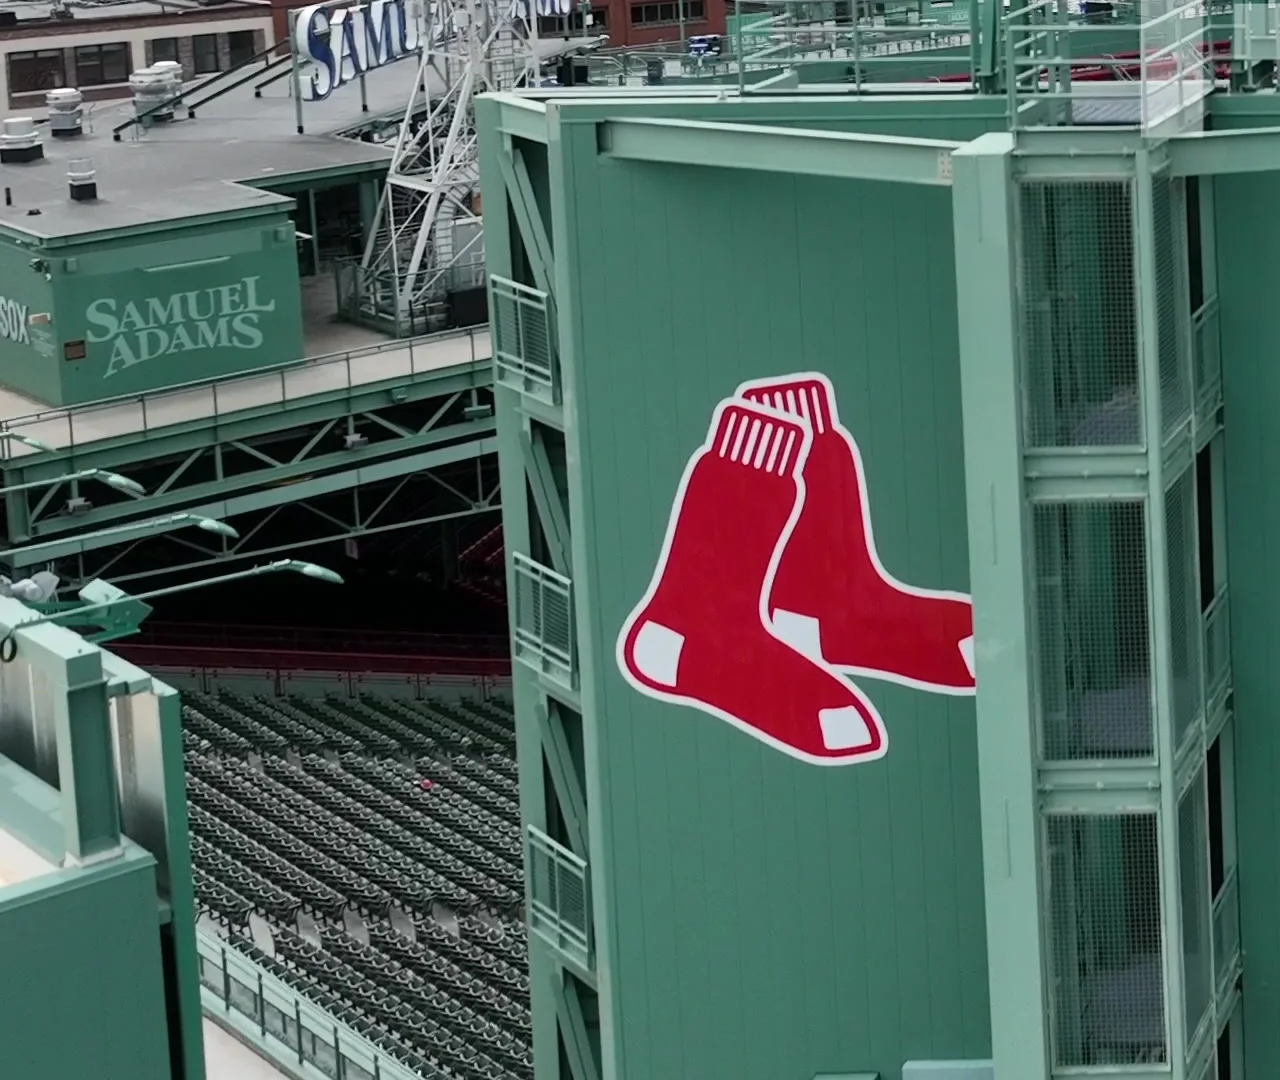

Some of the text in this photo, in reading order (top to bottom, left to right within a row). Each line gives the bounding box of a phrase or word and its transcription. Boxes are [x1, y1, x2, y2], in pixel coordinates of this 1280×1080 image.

[295, 0, 445, 102] SAMU
[0, 296, 29, 345] SOX
[86, 275, 275, 343] SAMUEL
[103, 313, 264, 378] ADAMS
